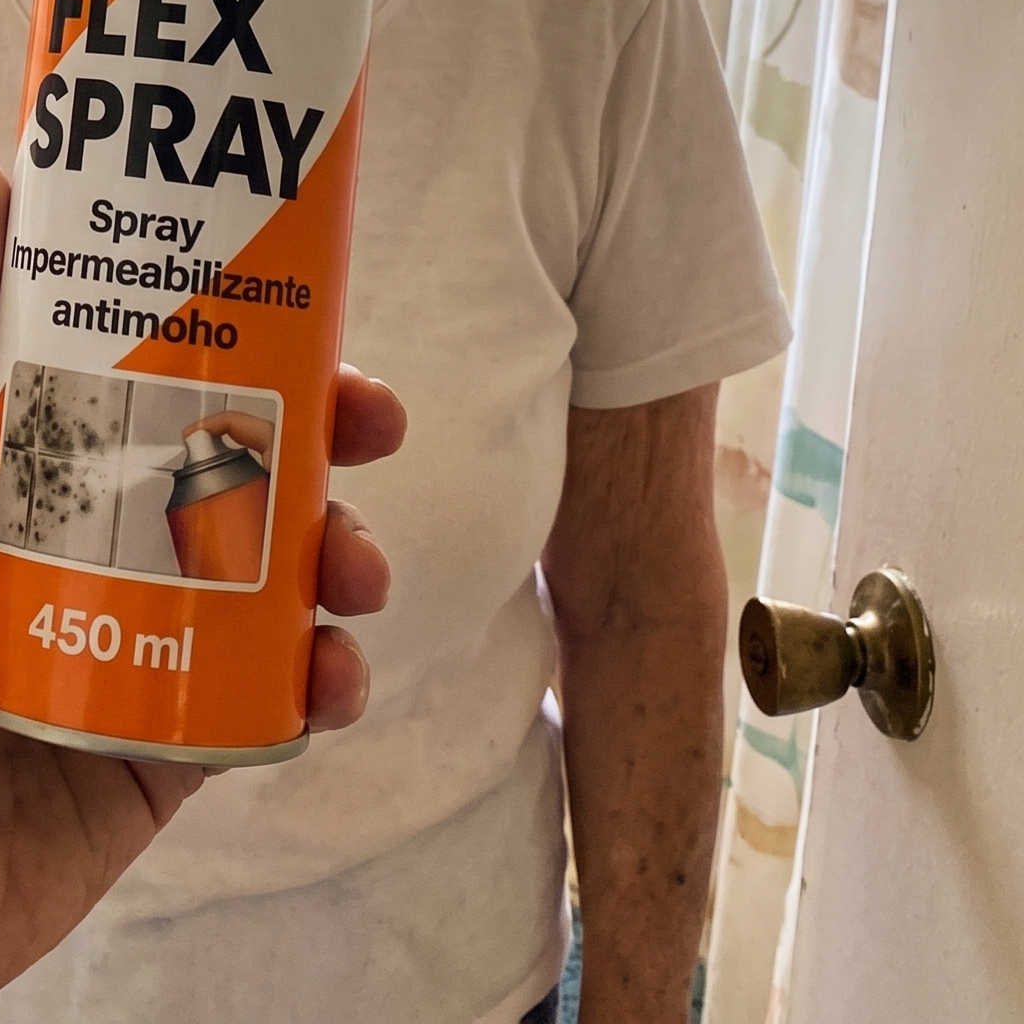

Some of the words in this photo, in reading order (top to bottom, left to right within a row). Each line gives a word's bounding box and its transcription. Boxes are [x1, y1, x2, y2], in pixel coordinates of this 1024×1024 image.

[30, 73, 324, 201] SPRAY
[89, 199, 205, 253] Spray
[10, 237, 311, 310] Impermeabilizante
[51, 295, 239, 350] antimoho
[28, 603, 122, 662] 450
[133, 627, 194, 673] ml
